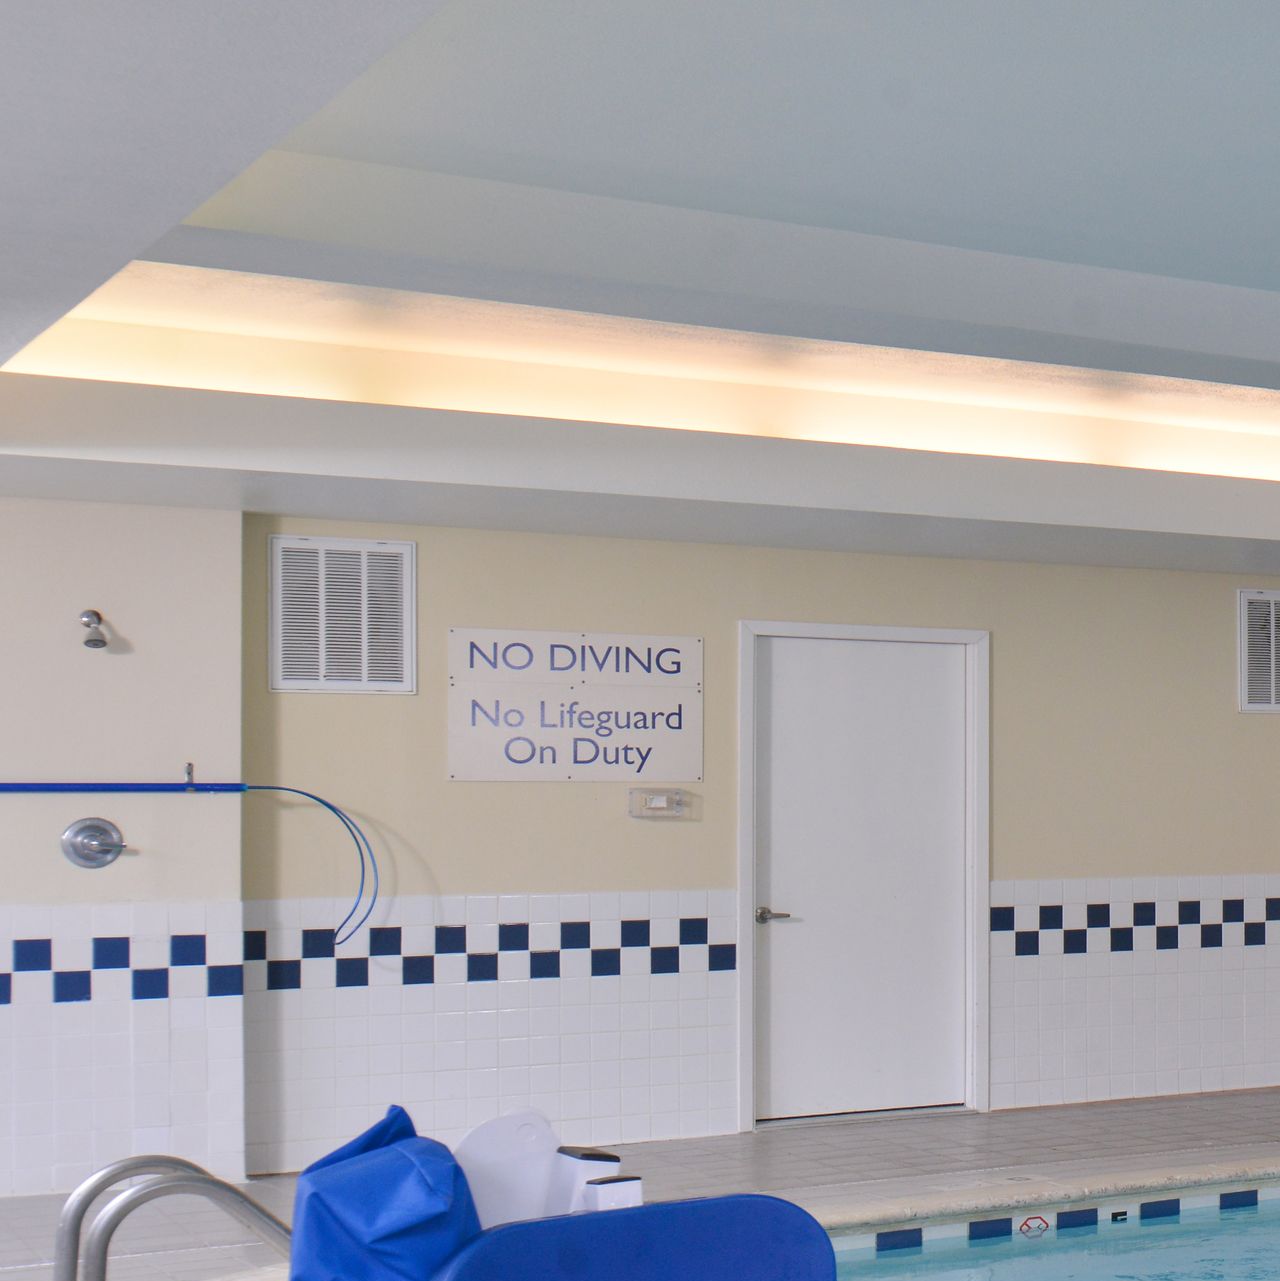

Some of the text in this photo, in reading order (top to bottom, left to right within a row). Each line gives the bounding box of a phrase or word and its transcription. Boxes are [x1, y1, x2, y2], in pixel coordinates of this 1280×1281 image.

[469, 641, 682, 675] NO DIVING
[471, 699, 683, 738] No Lifeguard
[504, 736, 653, 773] On Duty
